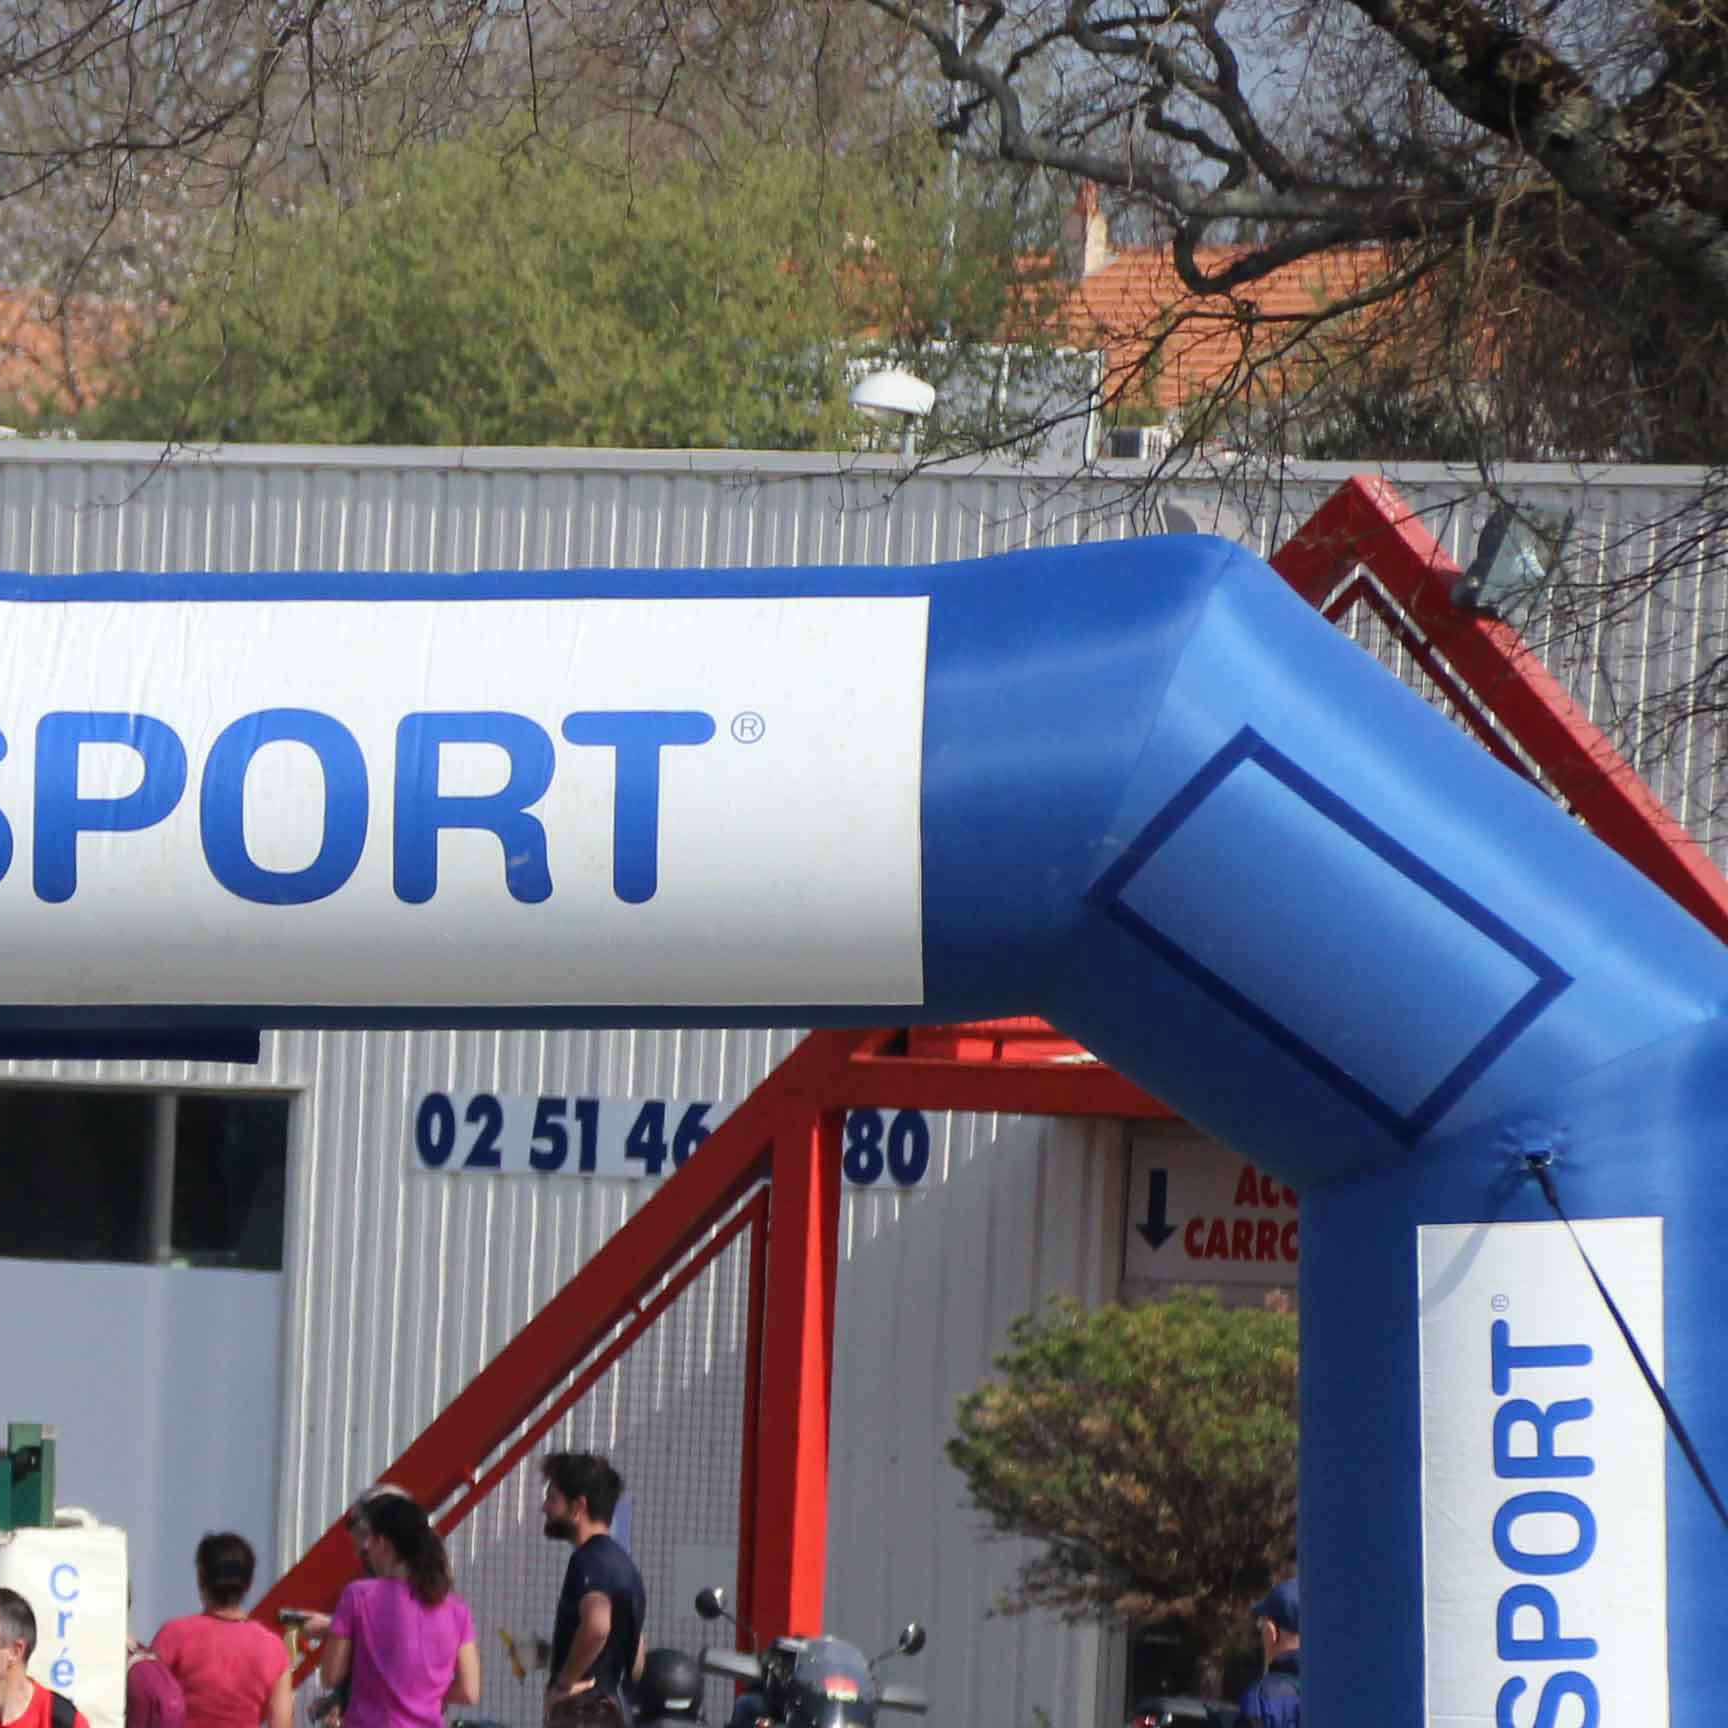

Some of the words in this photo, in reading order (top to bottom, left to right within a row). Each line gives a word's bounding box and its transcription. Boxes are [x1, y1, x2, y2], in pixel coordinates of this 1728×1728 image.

[414, 1091, 504, 1170] 02
[527, 1096, 600, 1174] 51
[843, 1107, 931, 1188] 80
